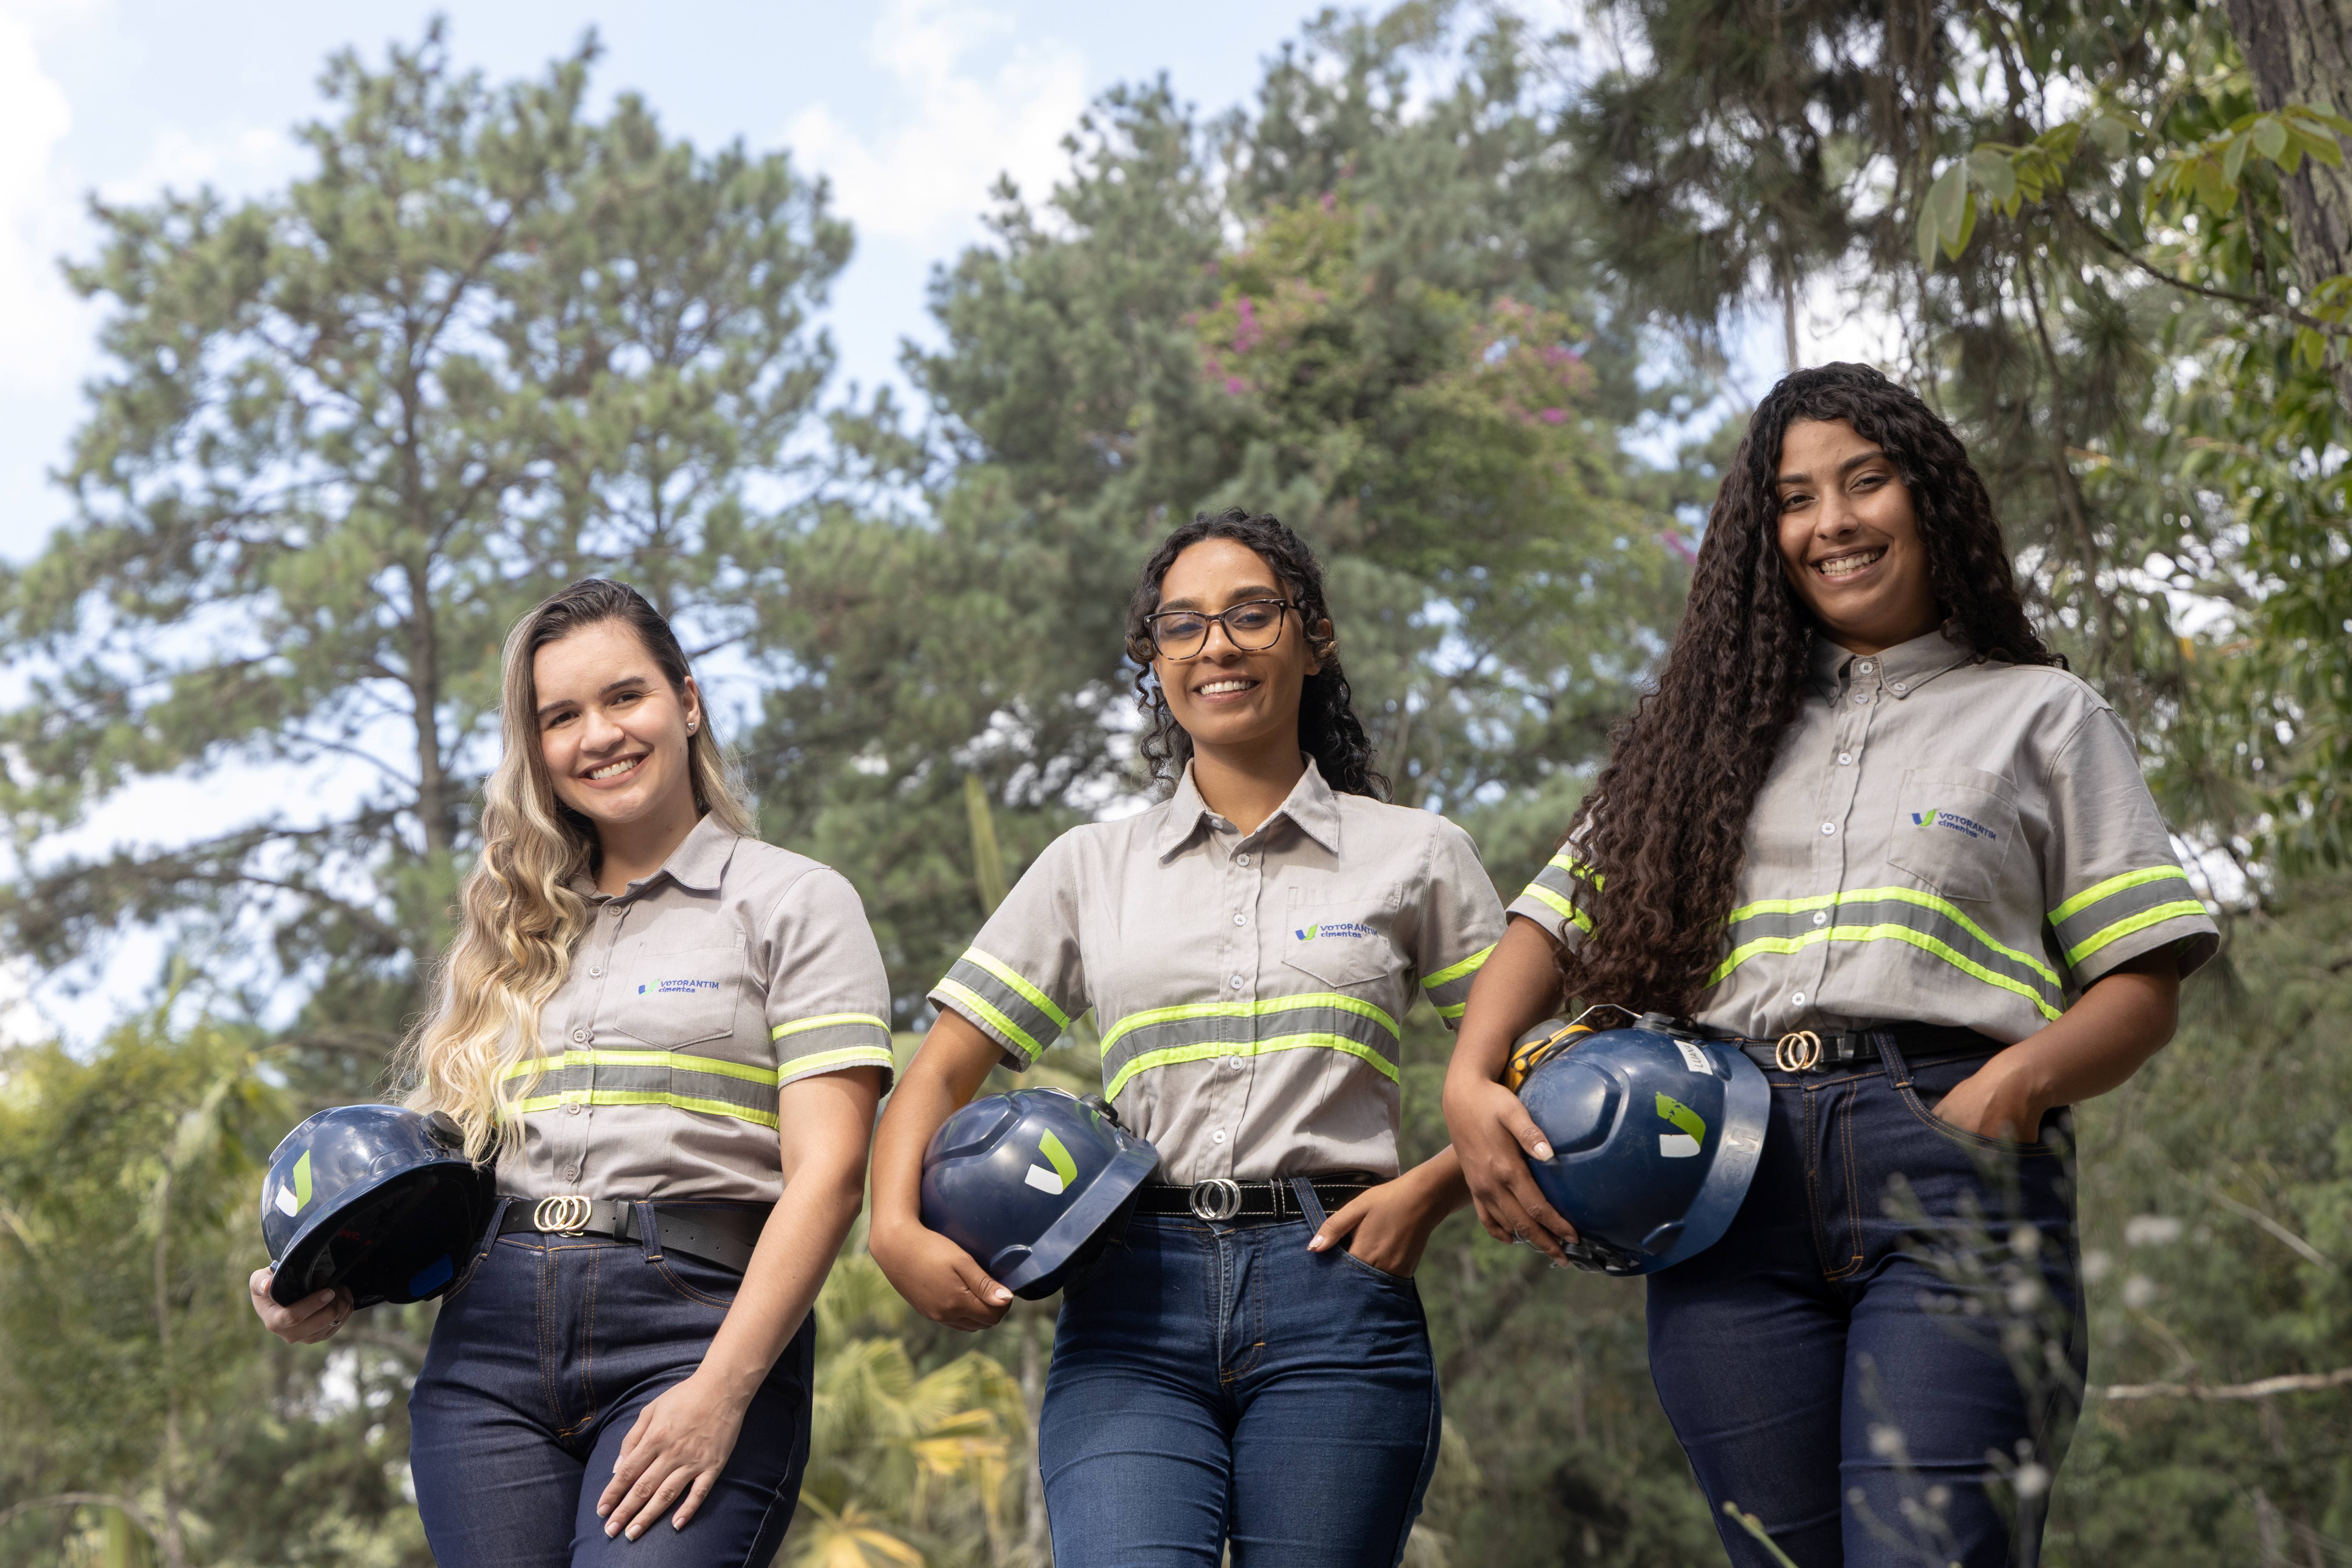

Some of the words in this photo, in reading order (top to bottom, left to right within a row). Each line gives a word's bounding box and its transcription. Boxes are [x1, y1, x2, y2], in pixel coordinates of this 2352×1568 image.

[1938, 820, 1978, 838] cimentos
[1939, 812, 1996, 841] VOTORANTIM
[1320, 923, 1378, 938] VOTORANTIM
[661, 980, 719, 989] VOTORANTIM
[1683, 1044, 1703, 1068] LUANA
[1719, 1125, 1762, 1186] 3M
